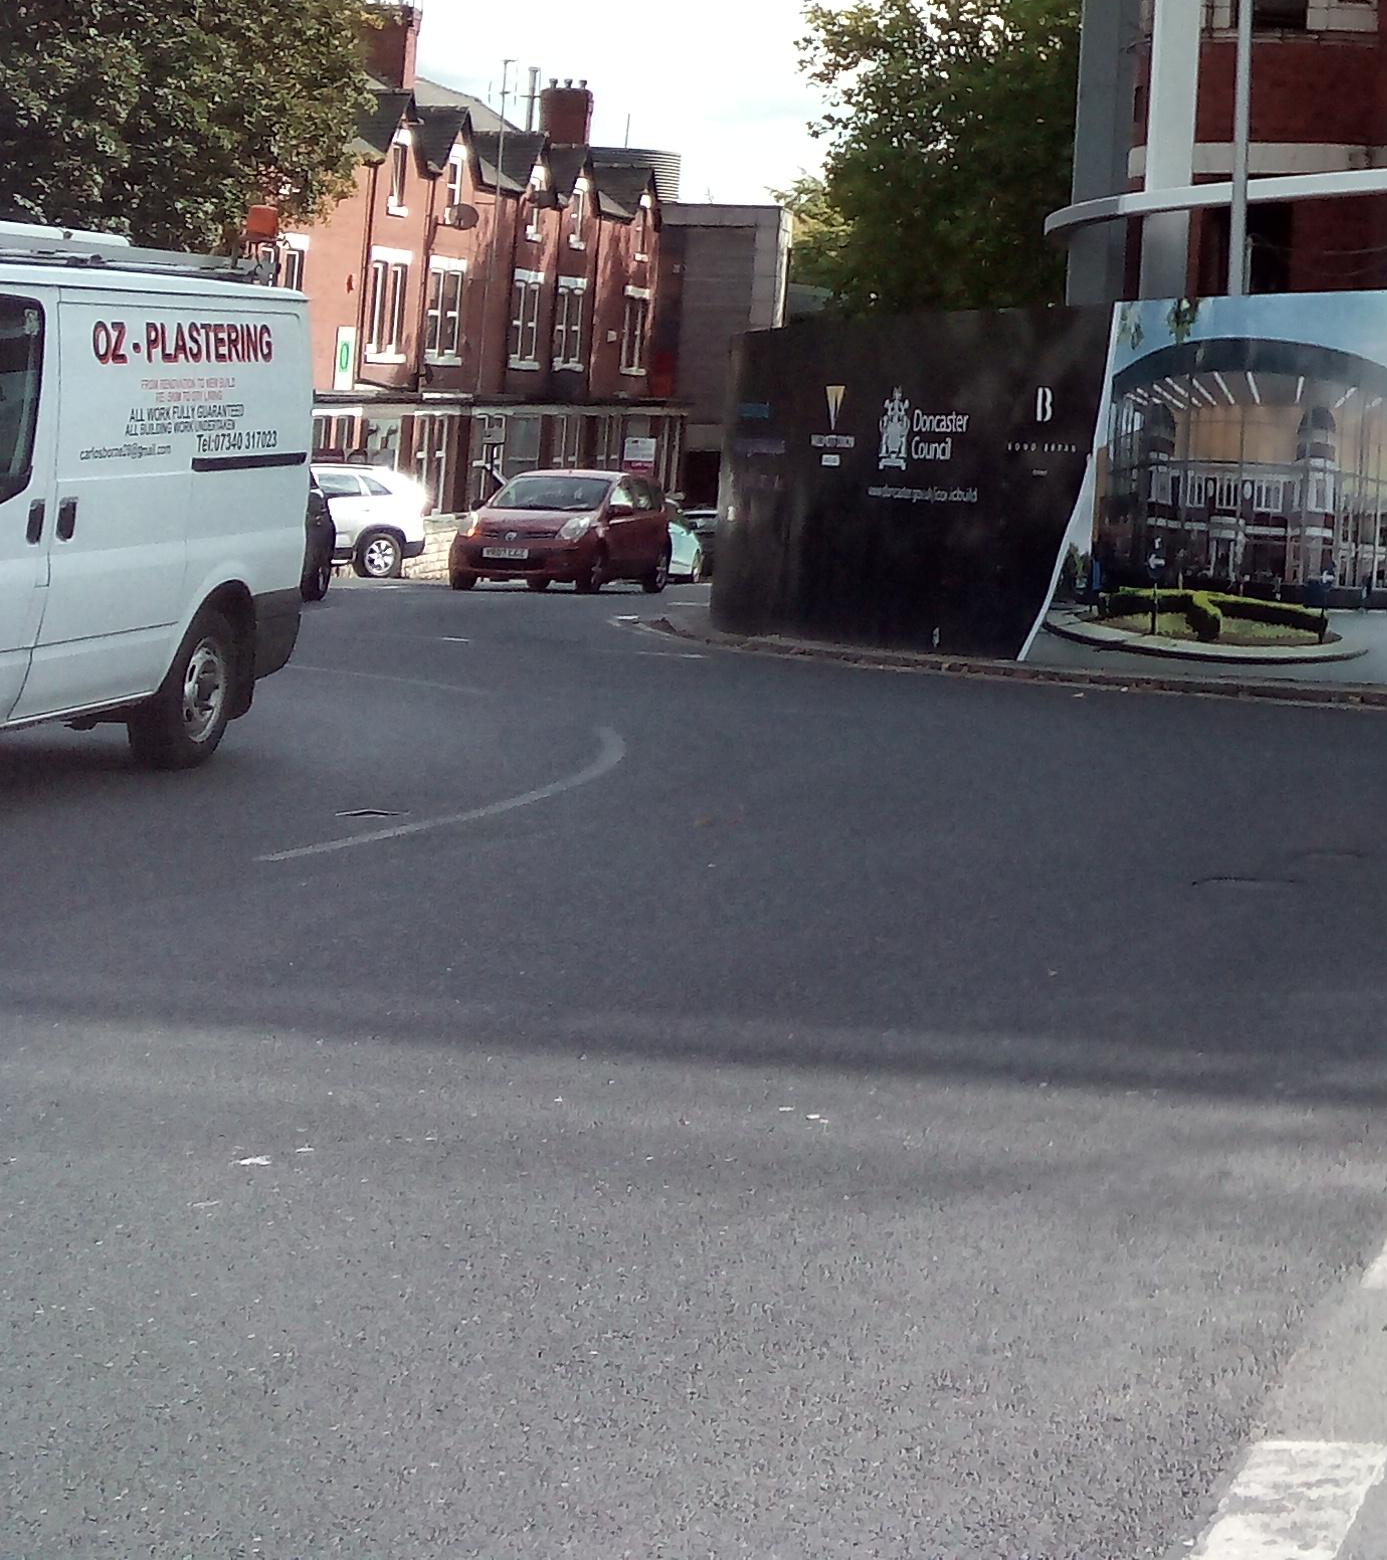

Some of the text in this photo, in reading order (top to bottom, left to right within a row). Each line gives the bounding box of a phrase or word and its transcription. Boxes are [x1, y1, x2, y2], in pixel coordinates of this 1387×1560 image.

[93, 321, 127, 364] OZ
[146, 321, 272, 363] PLASTERING
[129, 404, 244, 422] ALL WORK FULLY GUARANTEED
[1036, 387, 1054, 423] B
[125, 423, 138, 436] ALL
[140, 422, 172, 435] BUILDING
[174, 420, 194, 433] WORK
[913, 409, 970, 432] Doncaster
[912, 436, 952, 459] Council
